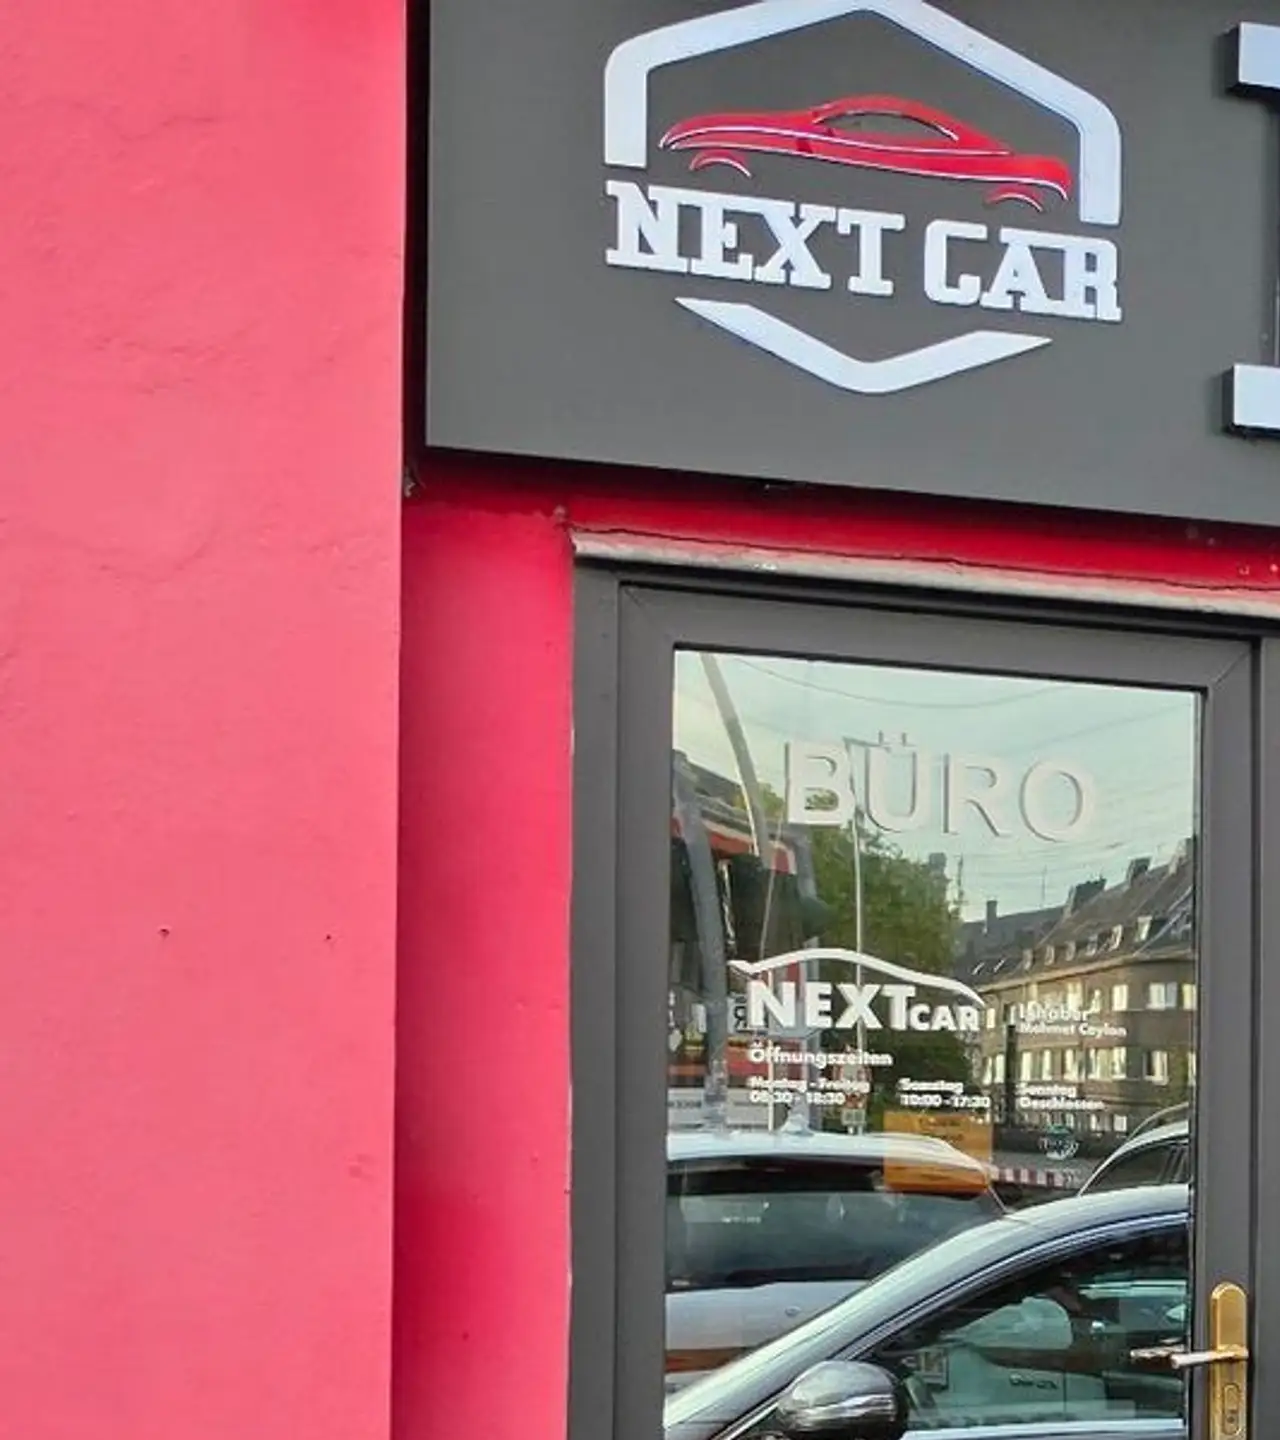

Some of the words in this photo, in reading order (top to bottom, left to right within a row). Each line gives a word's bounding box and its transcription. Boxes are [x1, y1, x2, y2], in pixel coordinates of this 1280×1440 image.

[605, 180, 906, 297] NEXT
[924, 218, 1122, 322] CAR
[785, 730, 1097, 843] BÜRO
[748, 1041, 893, 1069] Öffnungszeiten
